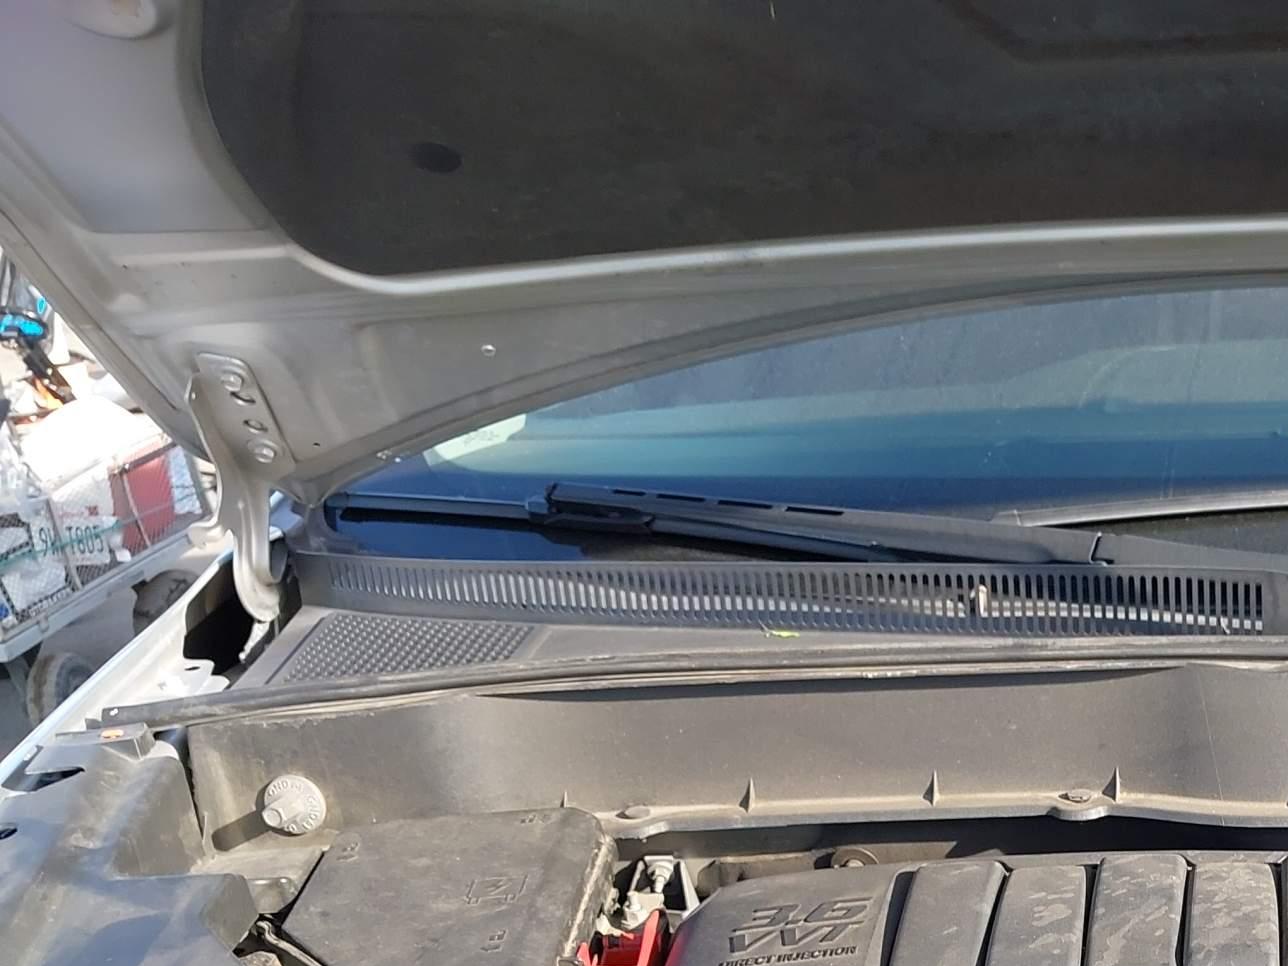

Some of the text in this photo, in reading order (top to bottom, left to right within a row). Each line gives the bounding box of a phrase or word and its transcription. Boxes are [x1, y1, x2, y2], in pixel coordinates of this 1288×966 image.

[731, 896, 874, 933] 3.6
[728, 920, 865, 954] VVT
[776, 945, 858, 964] INJECTION
